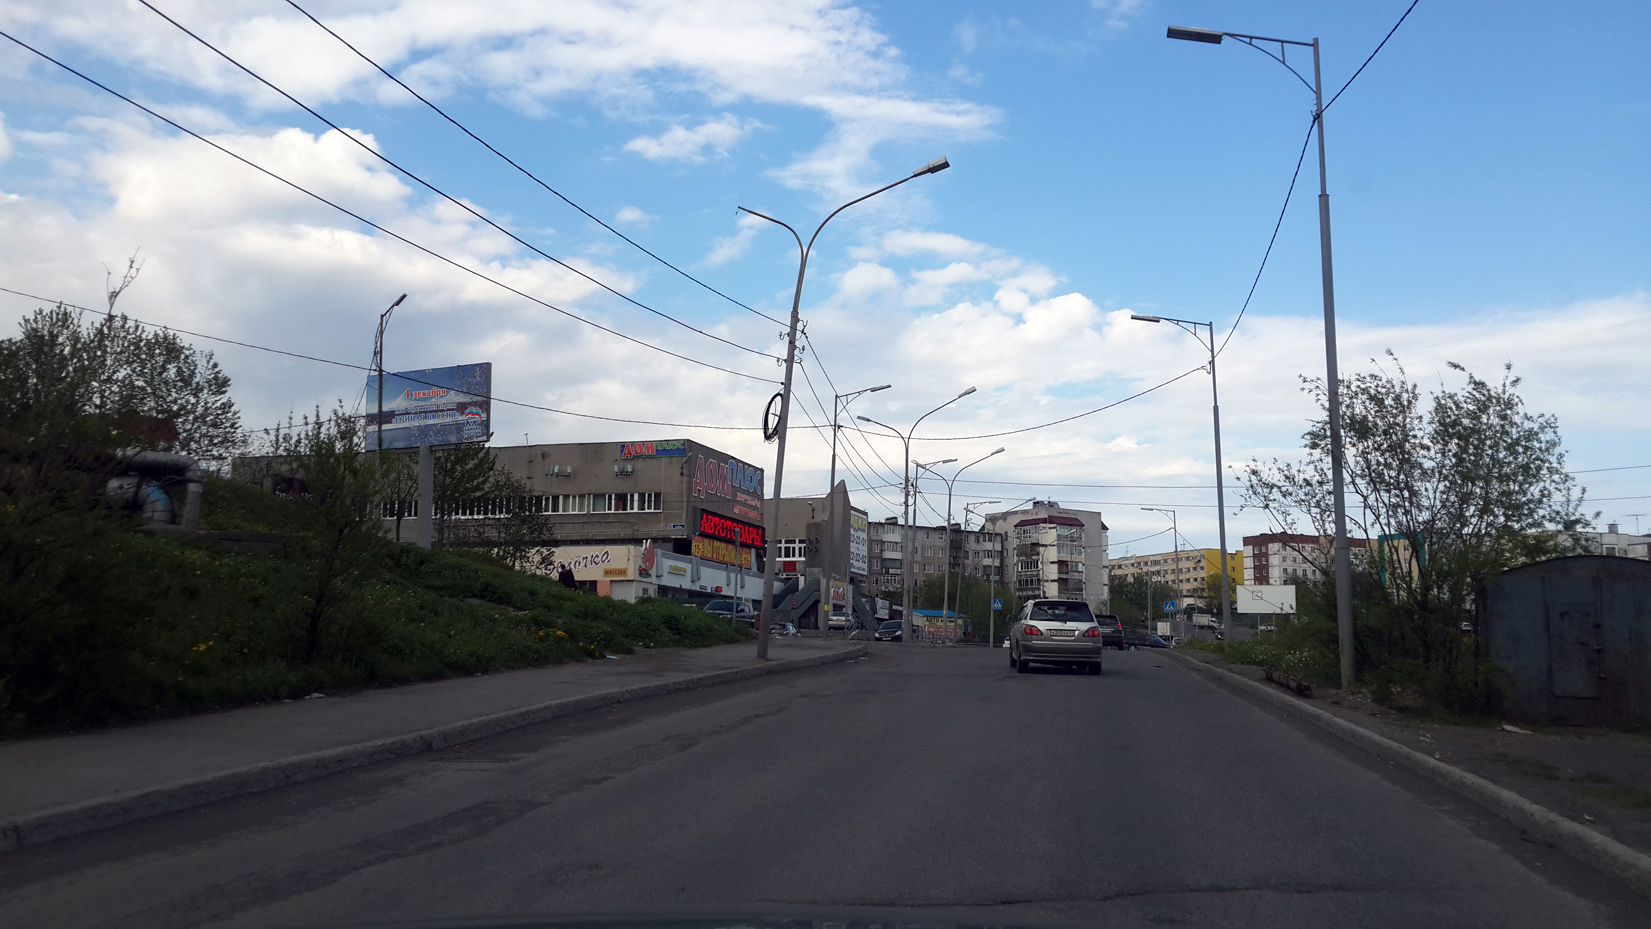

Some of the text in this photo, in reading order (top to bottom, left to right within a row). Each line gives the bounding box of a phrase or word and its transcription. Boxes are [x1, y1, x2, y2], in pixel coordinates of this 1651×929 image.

[406, 387, 446, 400] 1 декабря
[622, 441, 685, 459] ДОМ ПЛЮС
[692, 454, 762, 499] ДОМ ПЛЮС
